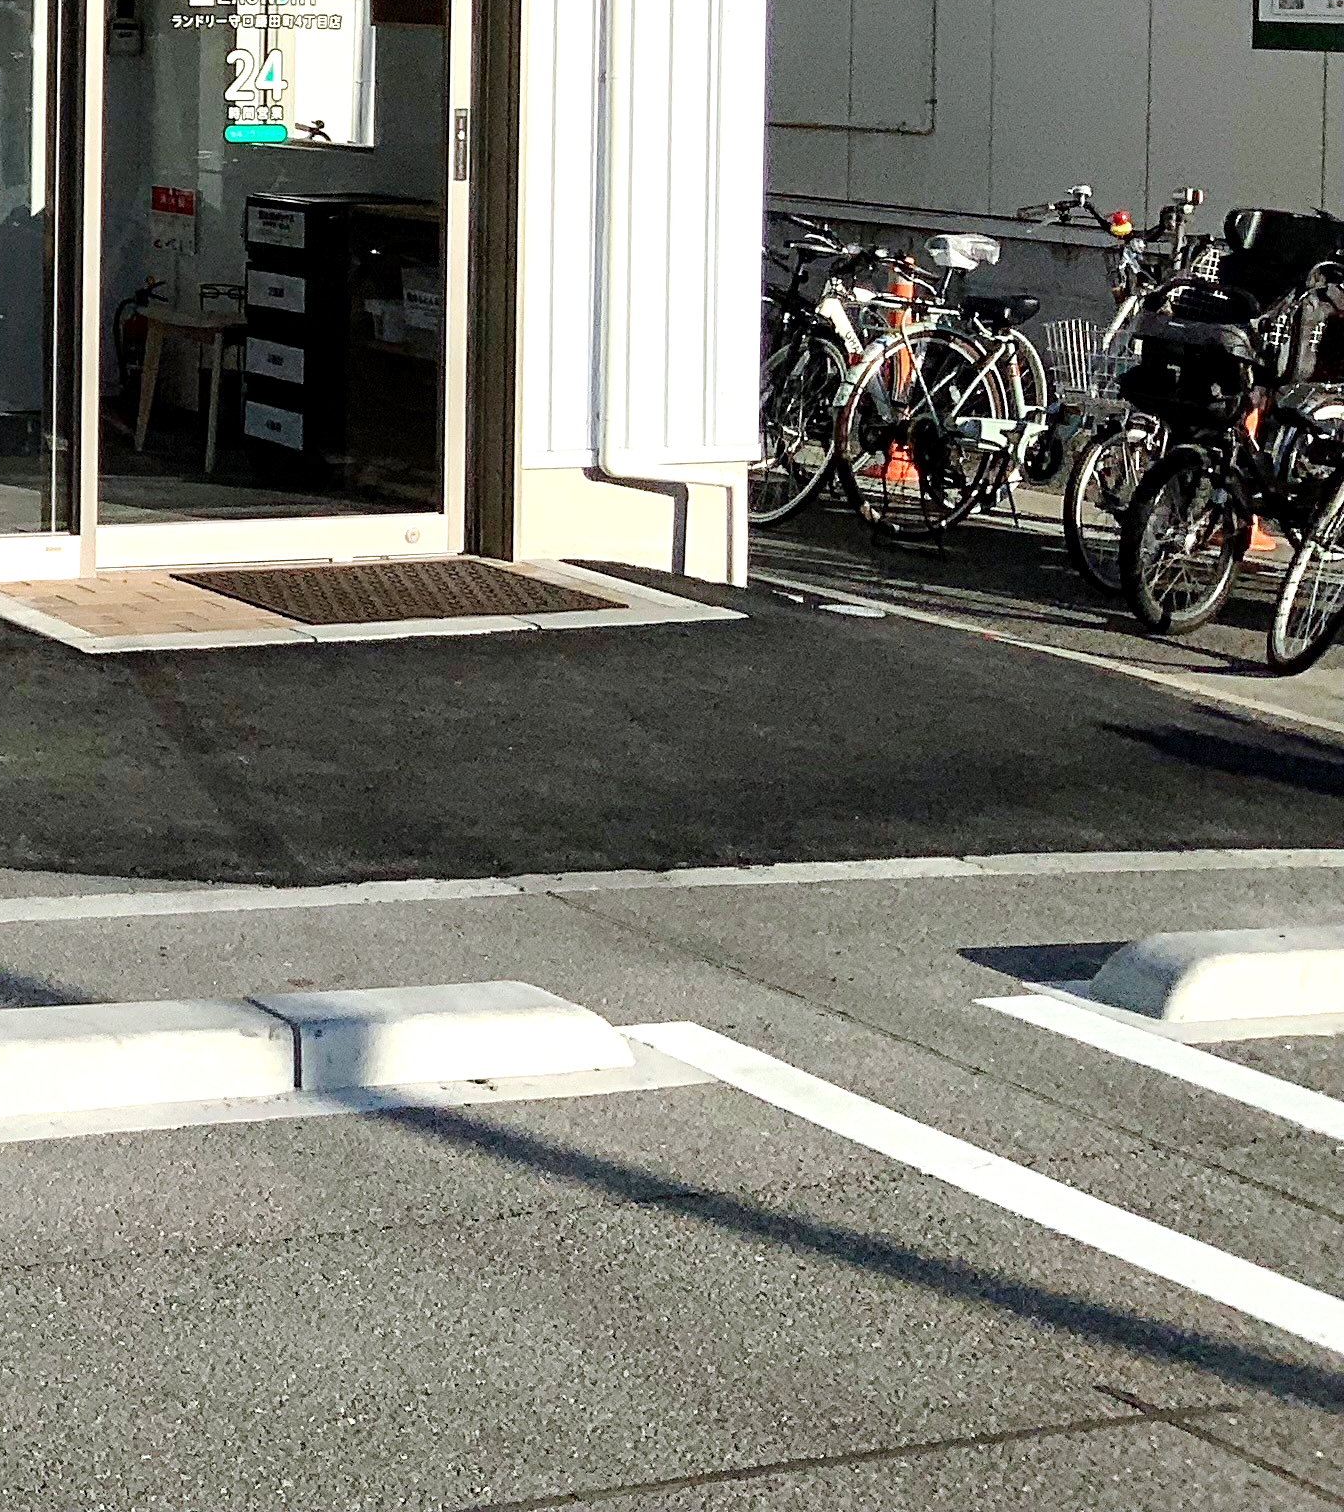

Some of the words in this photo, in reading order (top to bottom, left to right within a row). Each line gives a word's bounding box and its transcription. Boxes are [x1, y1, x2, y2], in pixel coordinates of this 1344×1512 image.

[224, 47, 289, 102] 24
[227, 105, 284, 121] 時間営業
